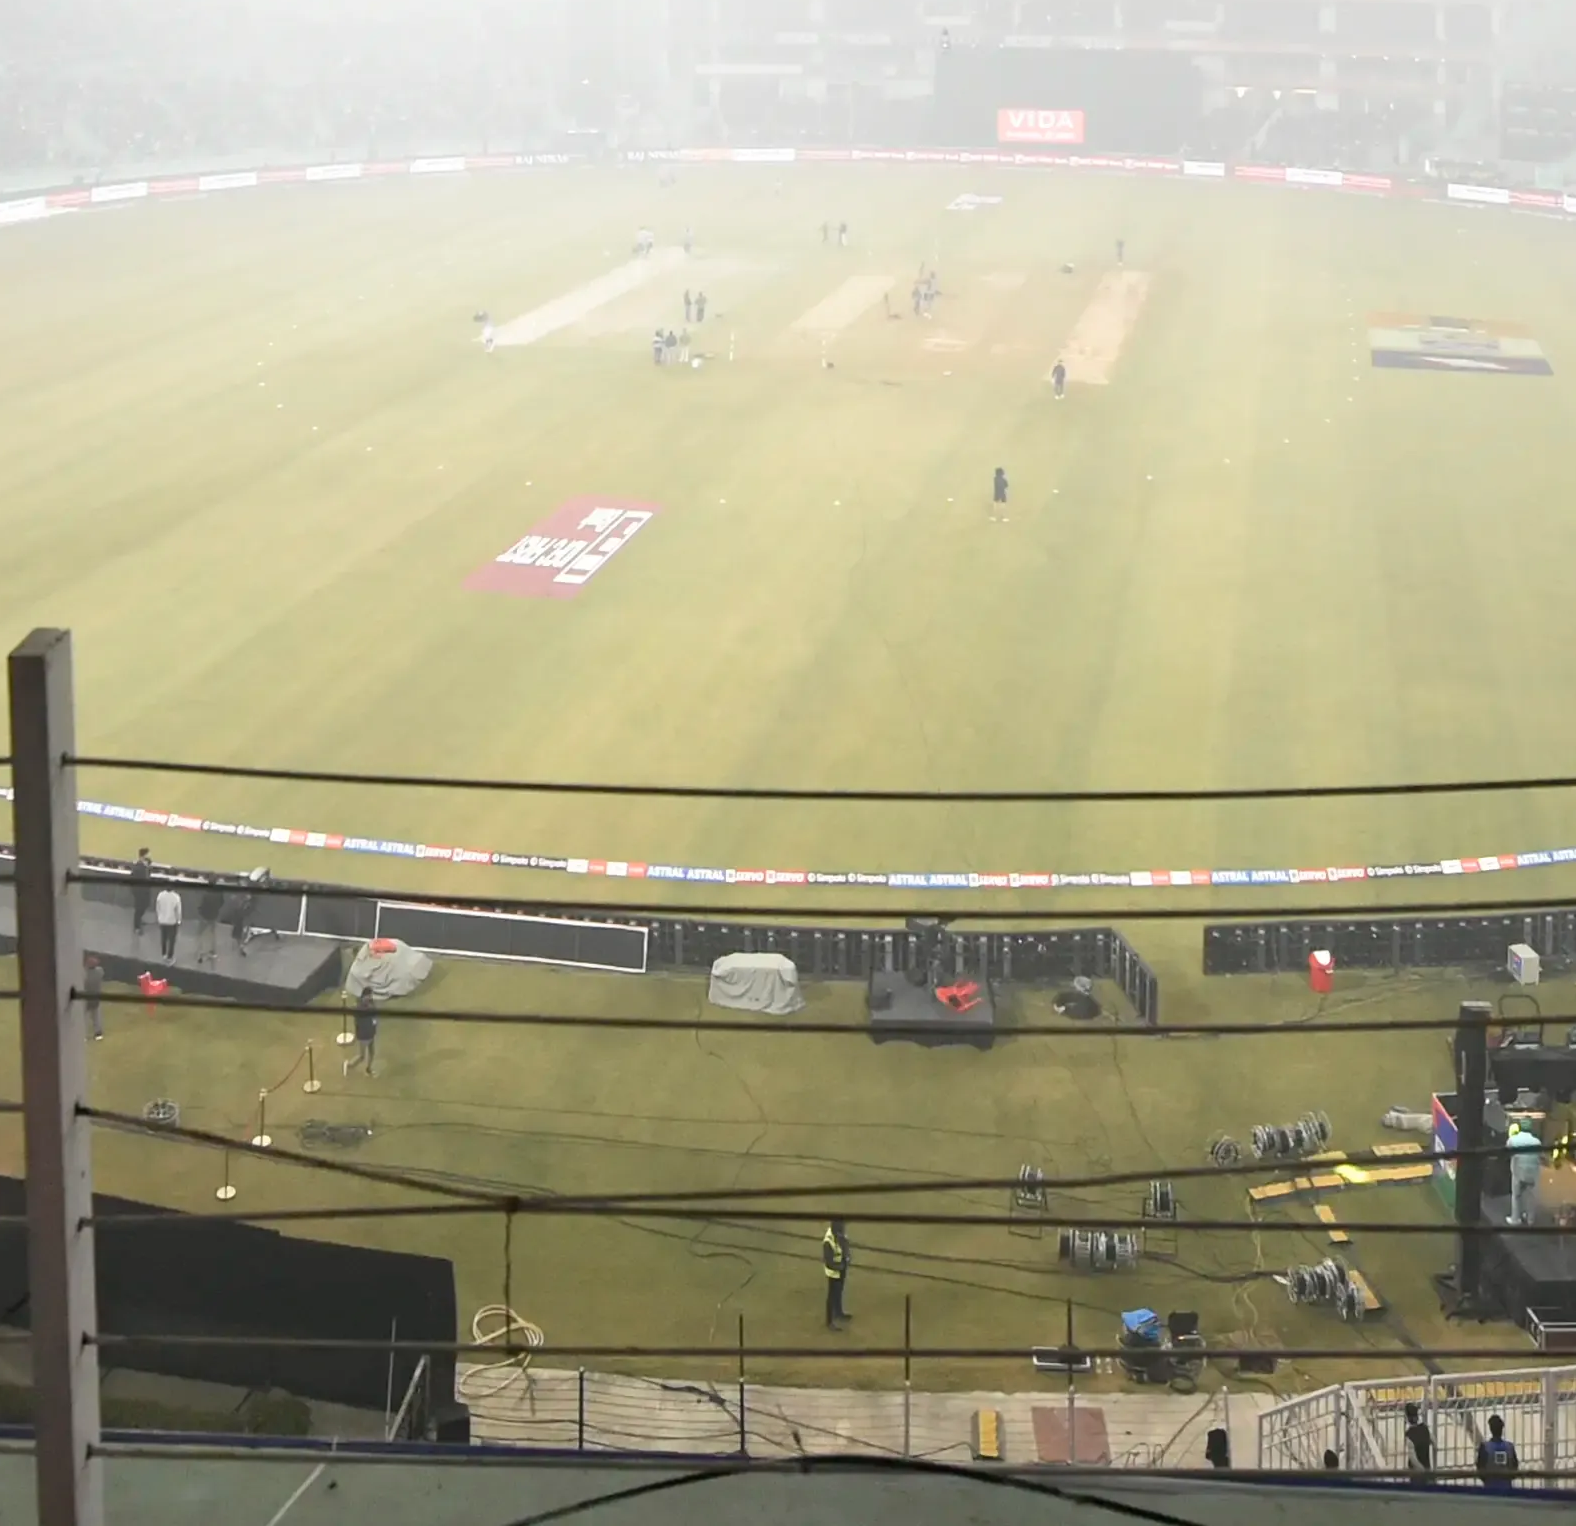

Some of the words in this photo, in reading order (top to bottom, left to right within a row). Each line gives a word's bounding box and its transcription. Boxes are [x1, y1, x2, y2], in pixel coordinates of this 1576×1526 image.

[1006, 110, 1075, 129] VIDA
[343, 838, 379, 851] ASTRAL
[379, 841, 415, 855] ASTRAL
[1517, 853, 1552, 866] ASTRAL
[647, 865, 685, 879] ASTRAL
[686, 868, 725, 882] ASTRAL
[888, 873, 928, 886] ASTRAL
[929, 873, 969, 886] ASTRAL
[1211, 870, 1250, 883] ASTRAL
[1251, 870, 1290, 883] ASTRAL
